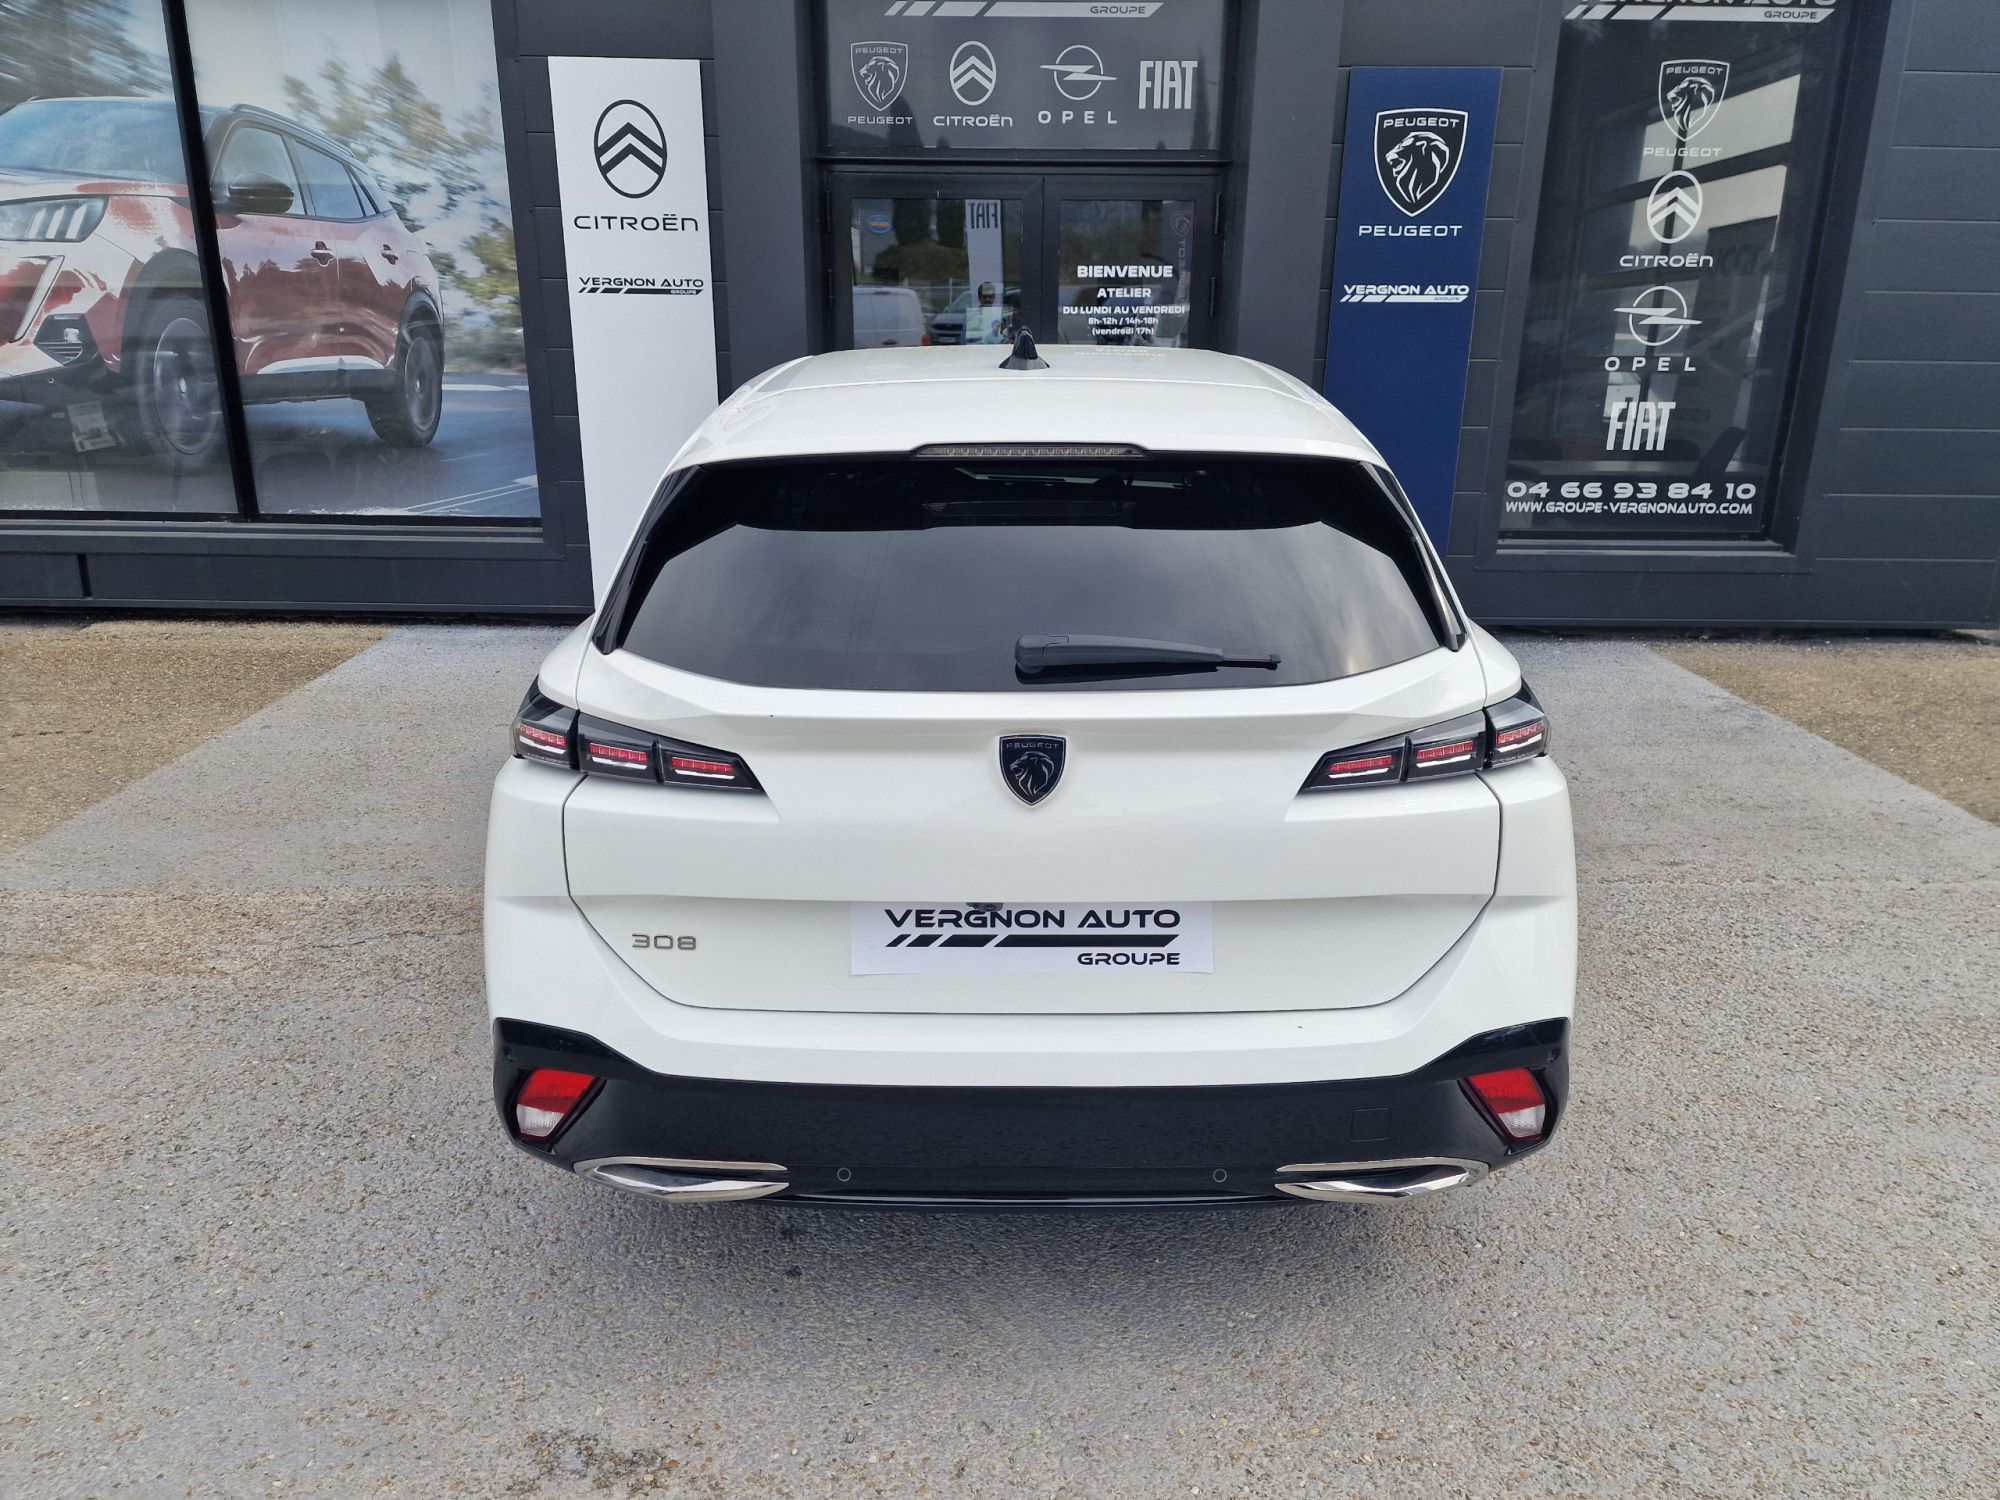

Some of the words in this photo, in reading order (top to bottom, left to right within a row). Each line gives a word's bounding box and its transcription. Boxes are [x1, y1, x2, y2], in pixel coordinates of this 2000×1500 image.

[1090, 6, 1146, 14] GROUPE
[1764, 10, 1818, 20] GROUPE
[855, 47, 903, 55] PEUGEOT
[1666, 65, 1724, 75] PEUGEOT
[1138, 60, 1198, 110] FIAT
[847, 116, 913, 124] PEUGEOT
[1037, 110, 1118, 124] OPEL
[1383, 117, 1460, 128] PEUGEOT
[1643, 147, 1724, 157] PEUGEOT
[1358, 225, 1463, 237] PEUGEOT
[1077, 265, 1173, 278] BIENVENUE
[579, 277, 656, 288] VERGNON
[660, 279, 704, 288] AUTO
[1097, 288, 1151, 298] ATELIER
[1344, 285, 1421, 294] VERGNON
[1424, 285, 1470, 294] AUTO
[1063, 306, 1078, 314] DU
[1080, 306, 1112, 314] LUNDI
[1114, 306, 1129, 314] AU
[1132, 306, 1185, 314] VENDREDI
[1604, 357, 1696, 372] OPEL
[1606, 402, 1676, 451] FIAT
[1507, 481, 1550, 498] 04
[1560, 482, 1603, 498] 66
[1613, 482, 1658, 498] 93
[1667, 482, 1713, 499] 84
[1725, 483, 1757, 499] 10
[1505, 501, 1753, 515] WWW.GROUPE-VERGNONAUTO.COM
[884, 909, 1065, 928] VERGNON
[1077, 909, 1181, 928] AUTO
[631, 933, 697, 950] 308
[1077, 952, 1181, 966] GROUPE
